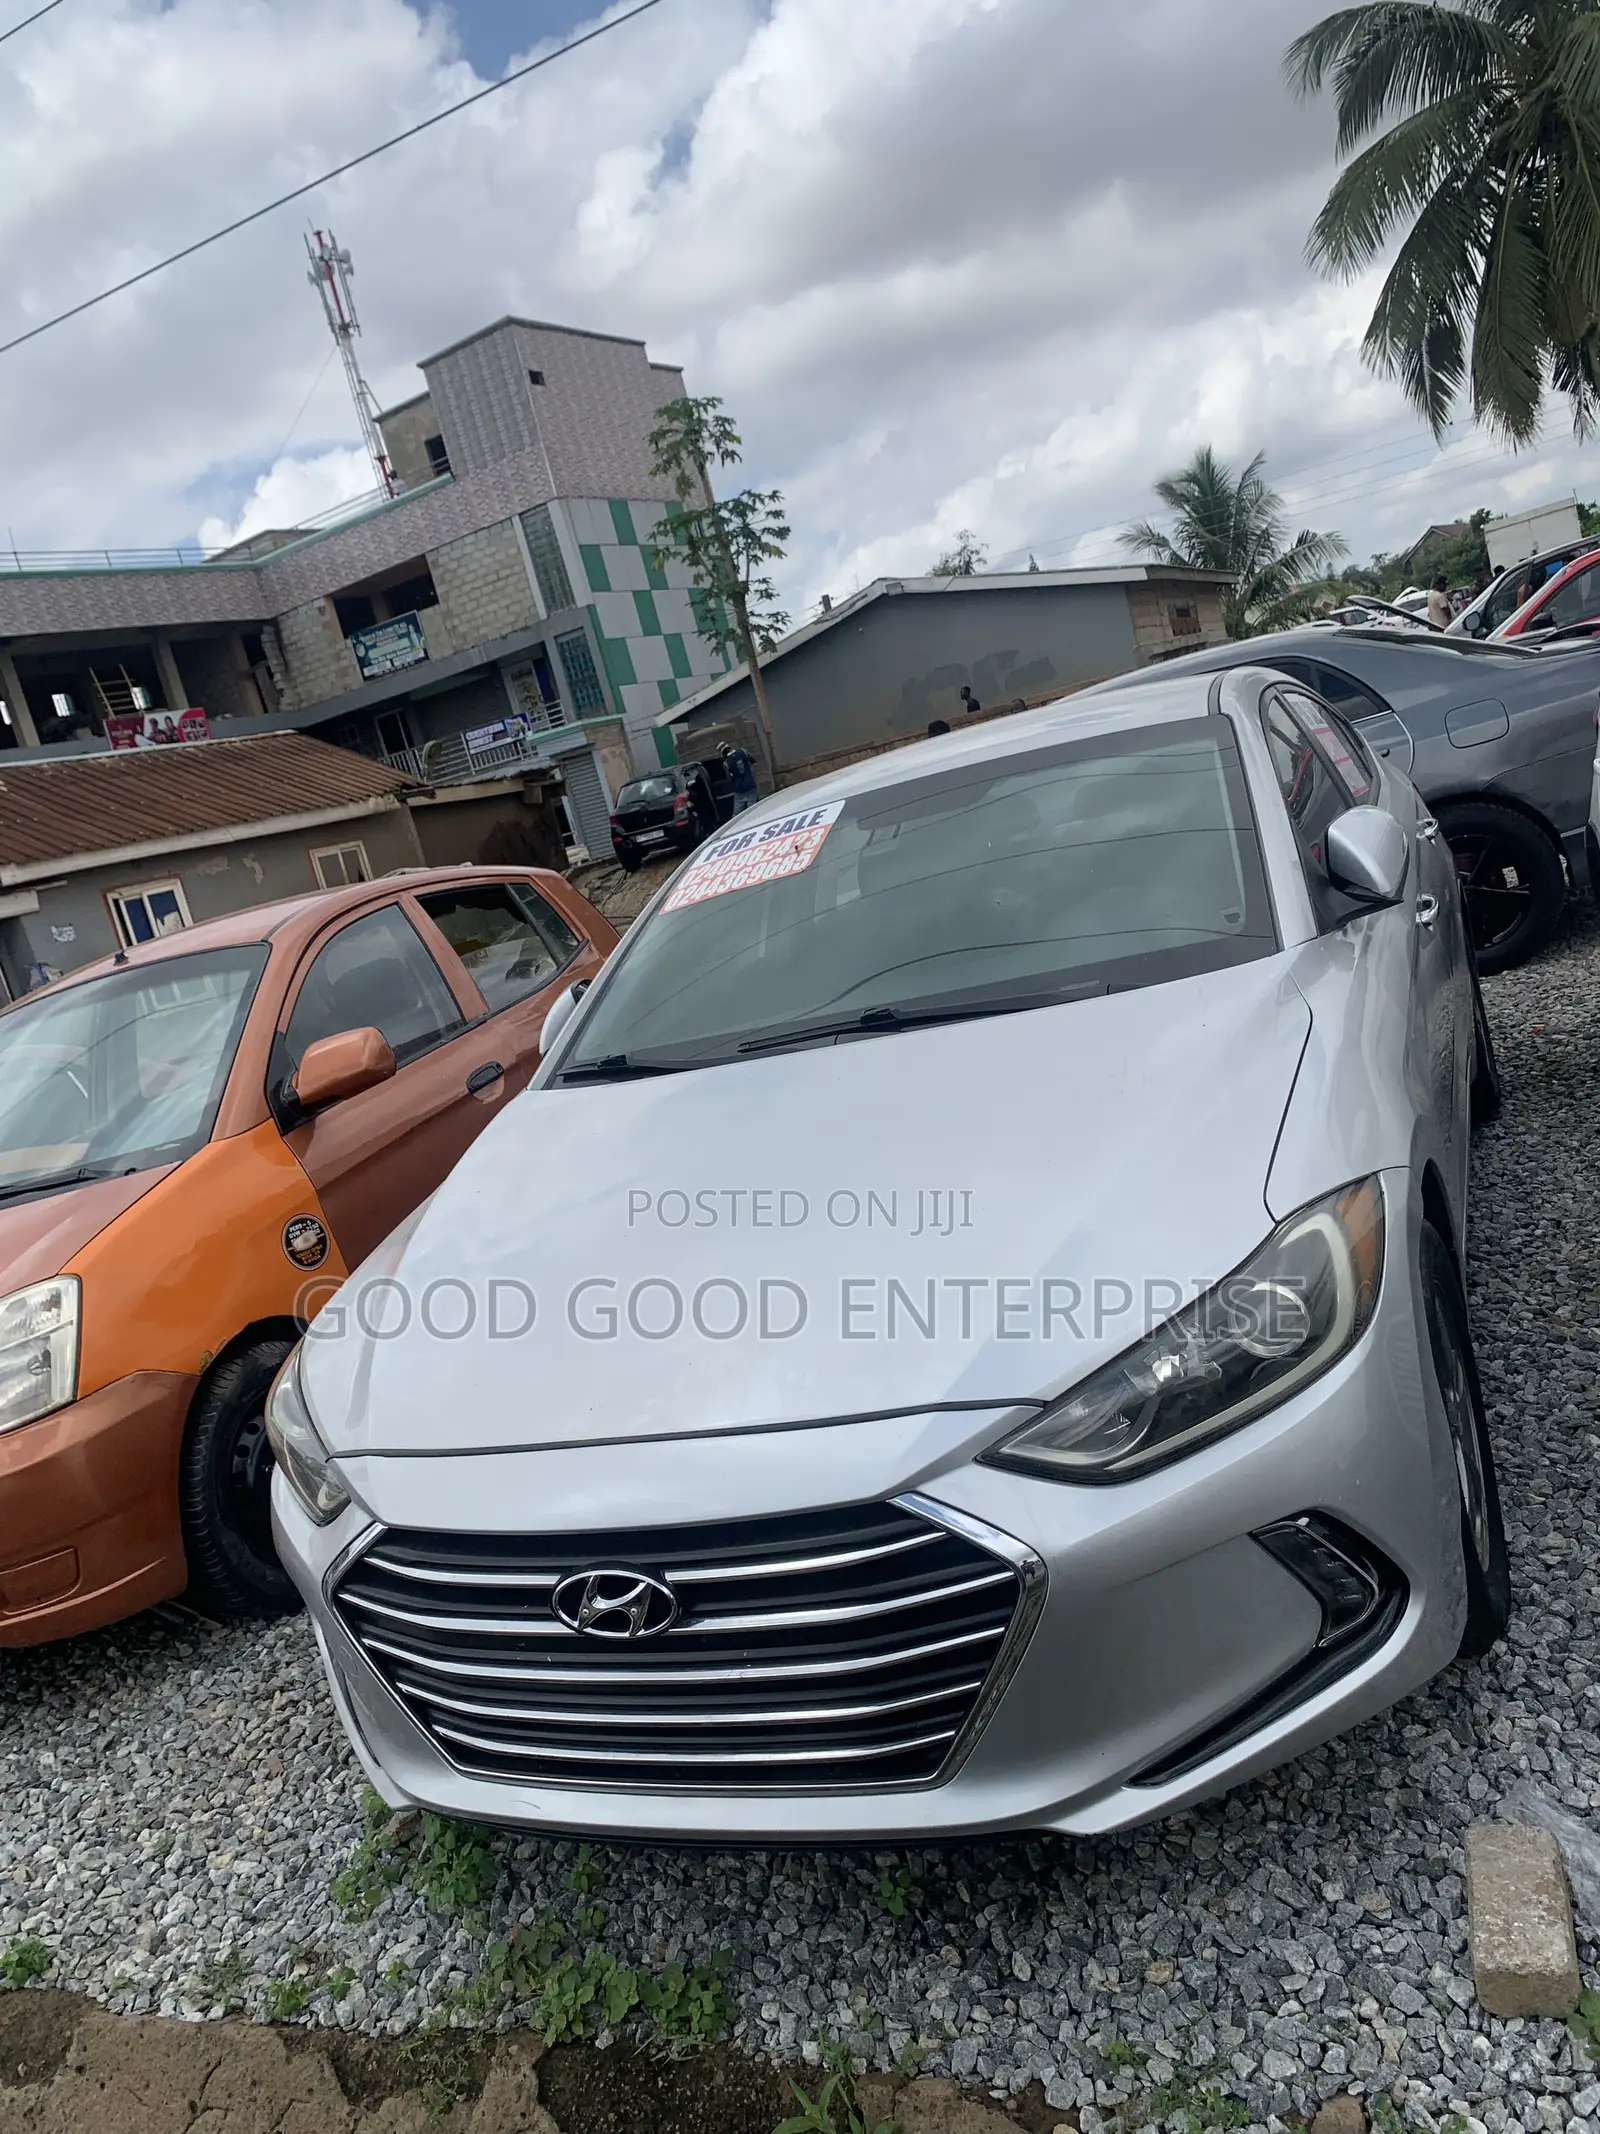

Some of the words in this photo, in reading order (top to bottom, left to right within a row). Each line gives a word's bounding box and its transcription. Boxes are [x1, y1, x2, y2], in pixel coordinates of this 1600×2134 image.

[677, 827, 825, 890] 0240962423
[703, 833, 753, 863] FOR
[758, 808, 828, 843] SALE
[664, 851, 812, 912] 0244369685
